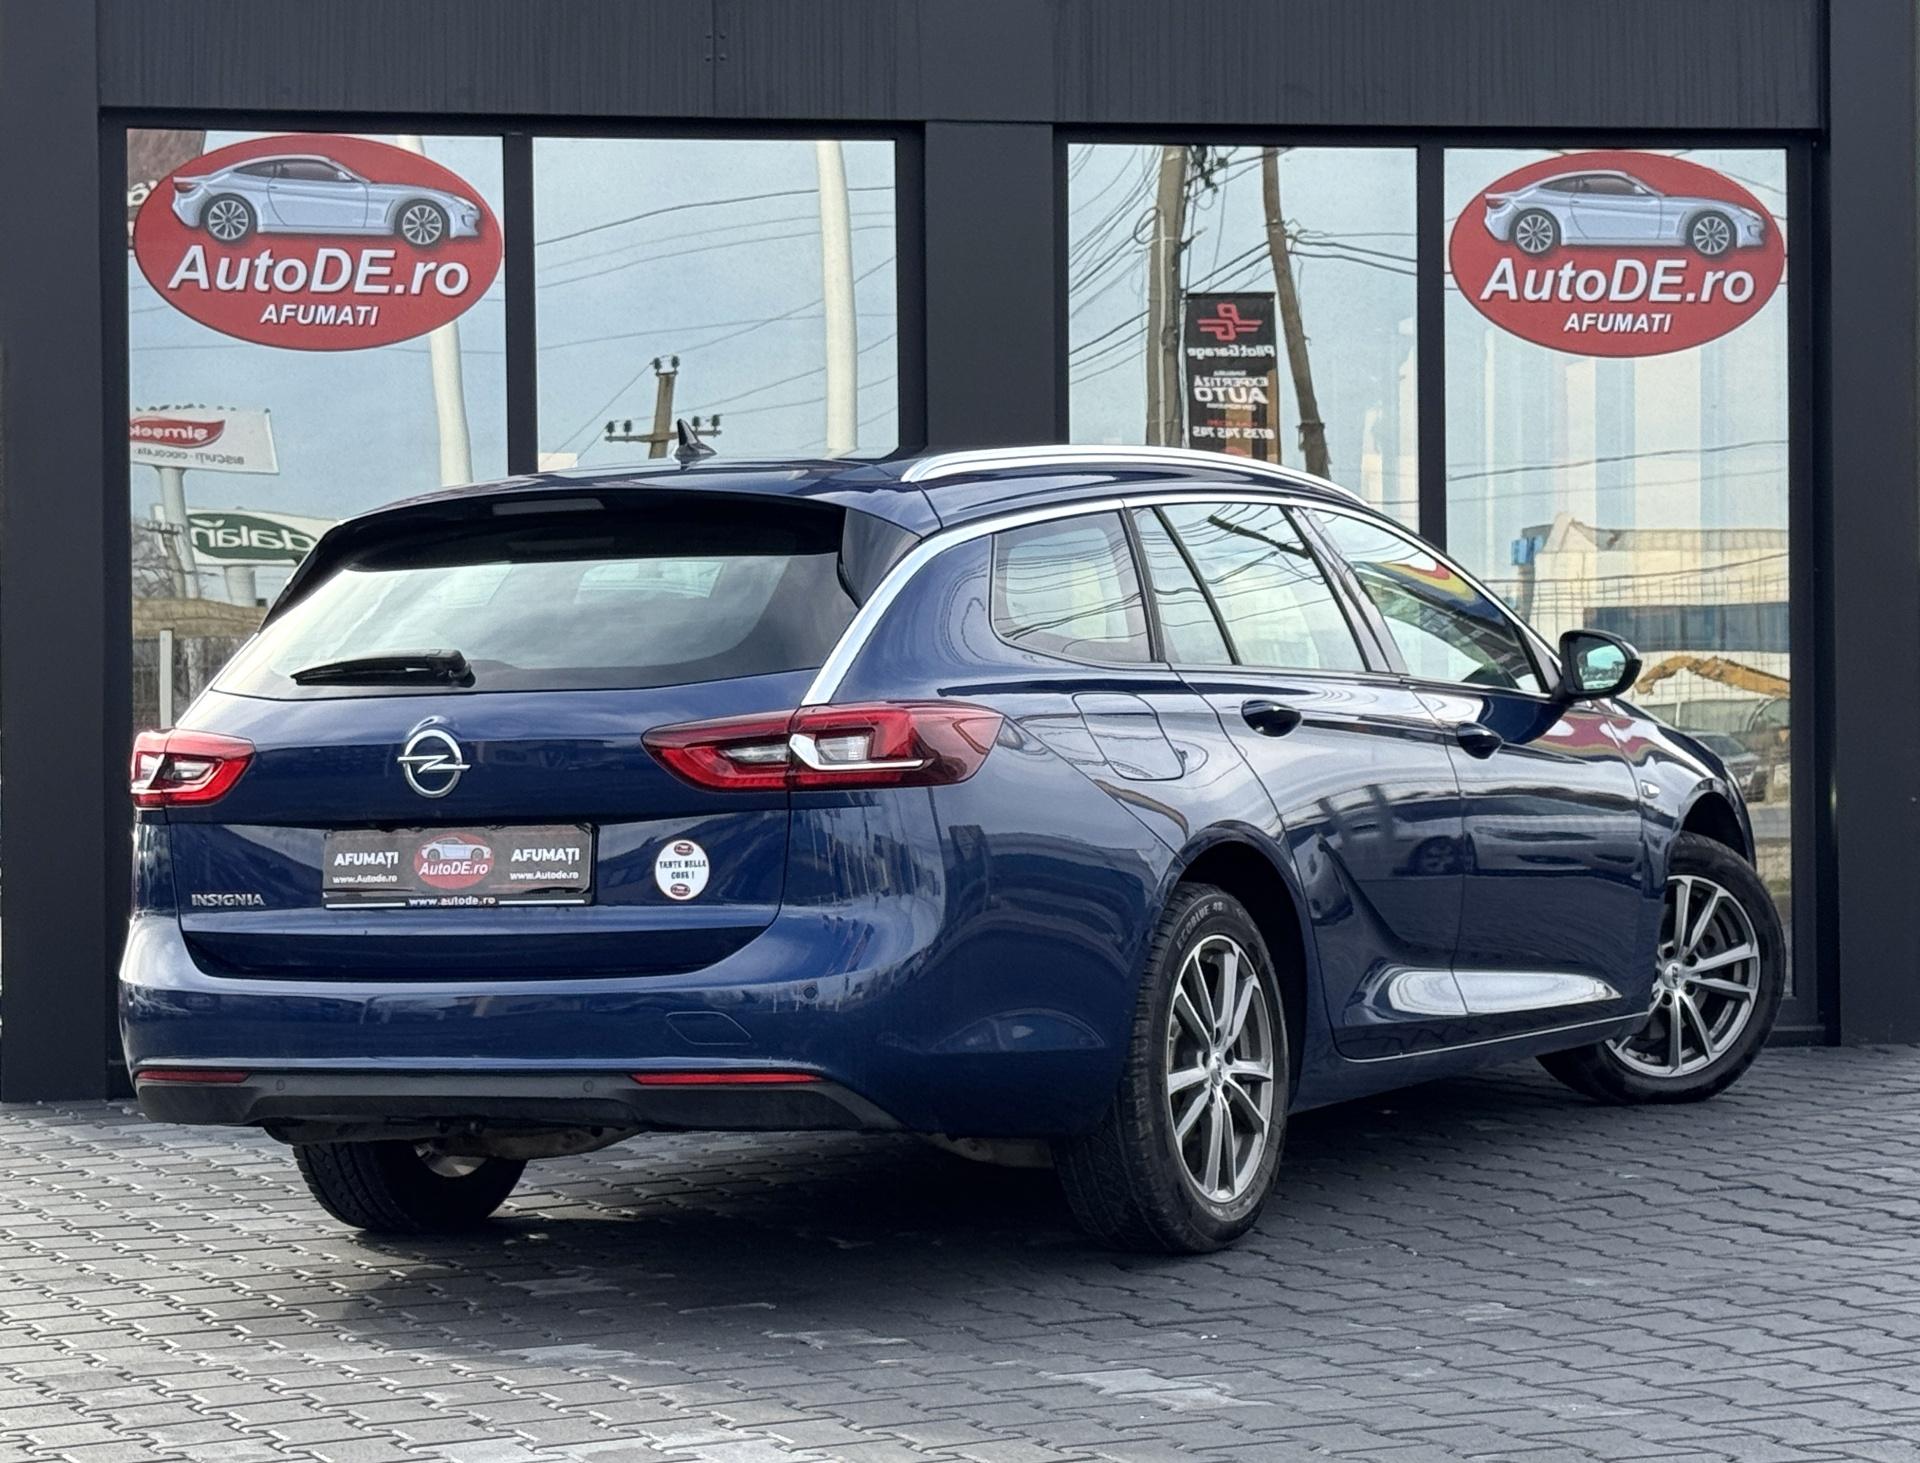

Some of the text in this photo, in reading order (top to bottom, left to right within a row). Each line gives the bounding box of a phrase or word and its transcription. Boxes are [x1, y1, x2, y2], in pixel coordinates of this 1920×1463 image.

[167, 245, 469, 296] AutoDE.ro
[1480, 257, 1755, 303] AutoDE.ro
[260, 304, 379, 326] AFUMATI
[1563, 313, 1672, 333] AFUMATI
[419, 861, 489, 876] AutoDE.ro
[191, 893, 266, 907] INSIGNIA
[408, 896, 496, 906] www.autode.ro
